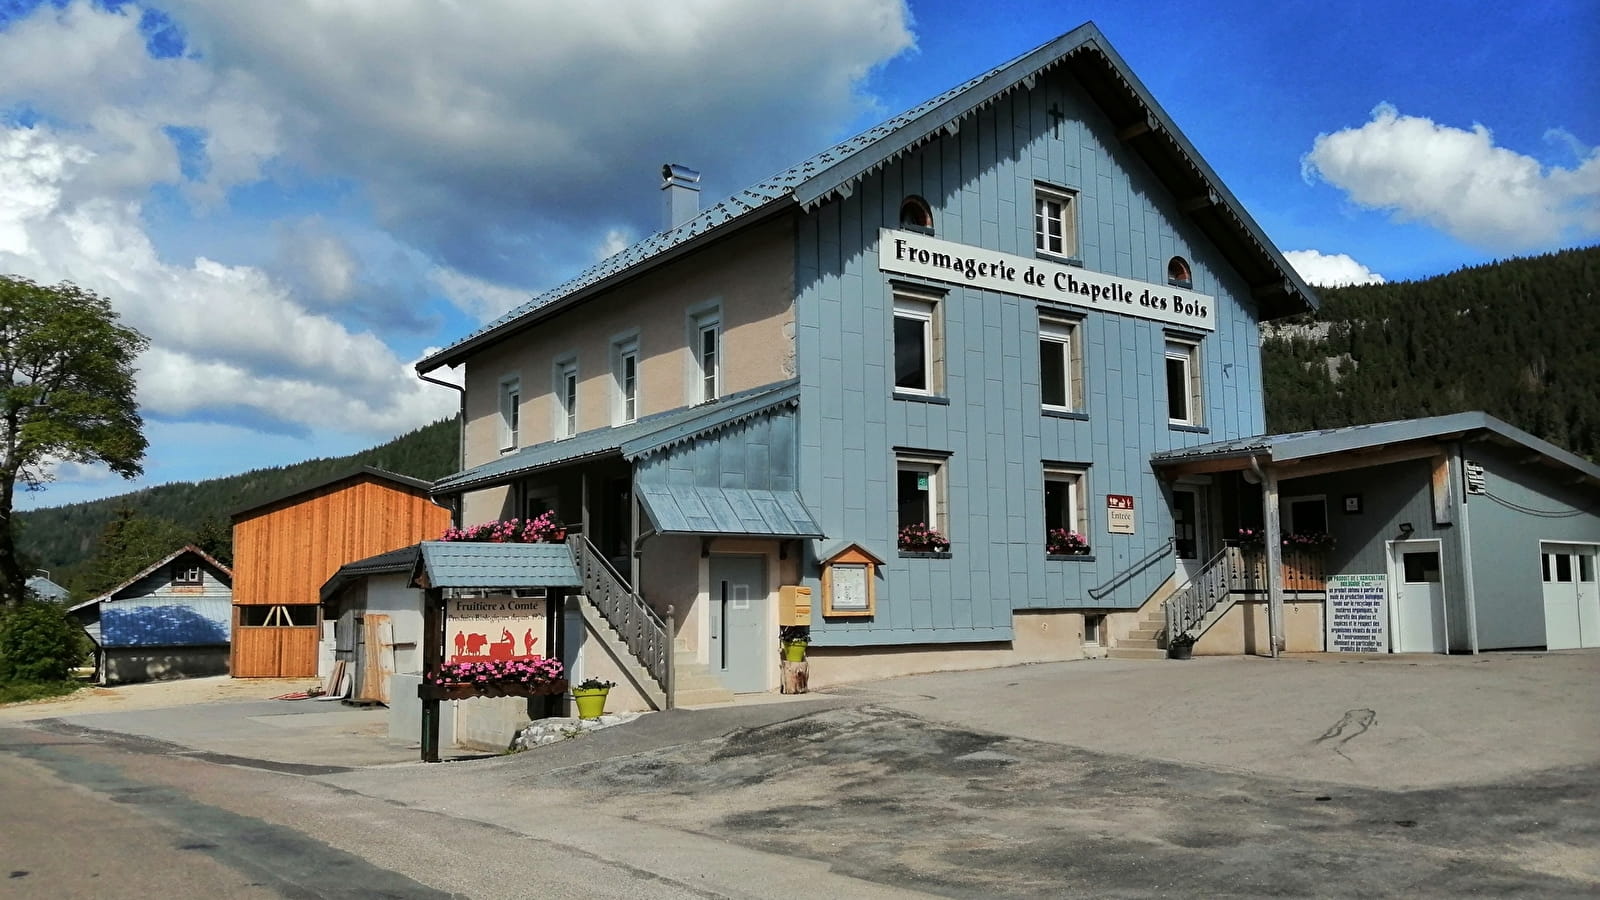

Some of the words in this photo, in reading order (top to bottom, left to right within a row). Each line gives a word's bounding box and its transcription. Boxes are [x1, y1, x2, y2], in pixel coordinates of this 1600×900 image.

[894, 238, 1016, 280] Fromagerie
[1023, 266, 1046, 287] de
[1054, 271, 1133, 304] Chapelle
[1140, 289, 1167, 311] des
[1173, 295, 1208, 319] Bois
[456, 600, 498, 611] Fruitière
[508, 600, 538, 610] Comté
